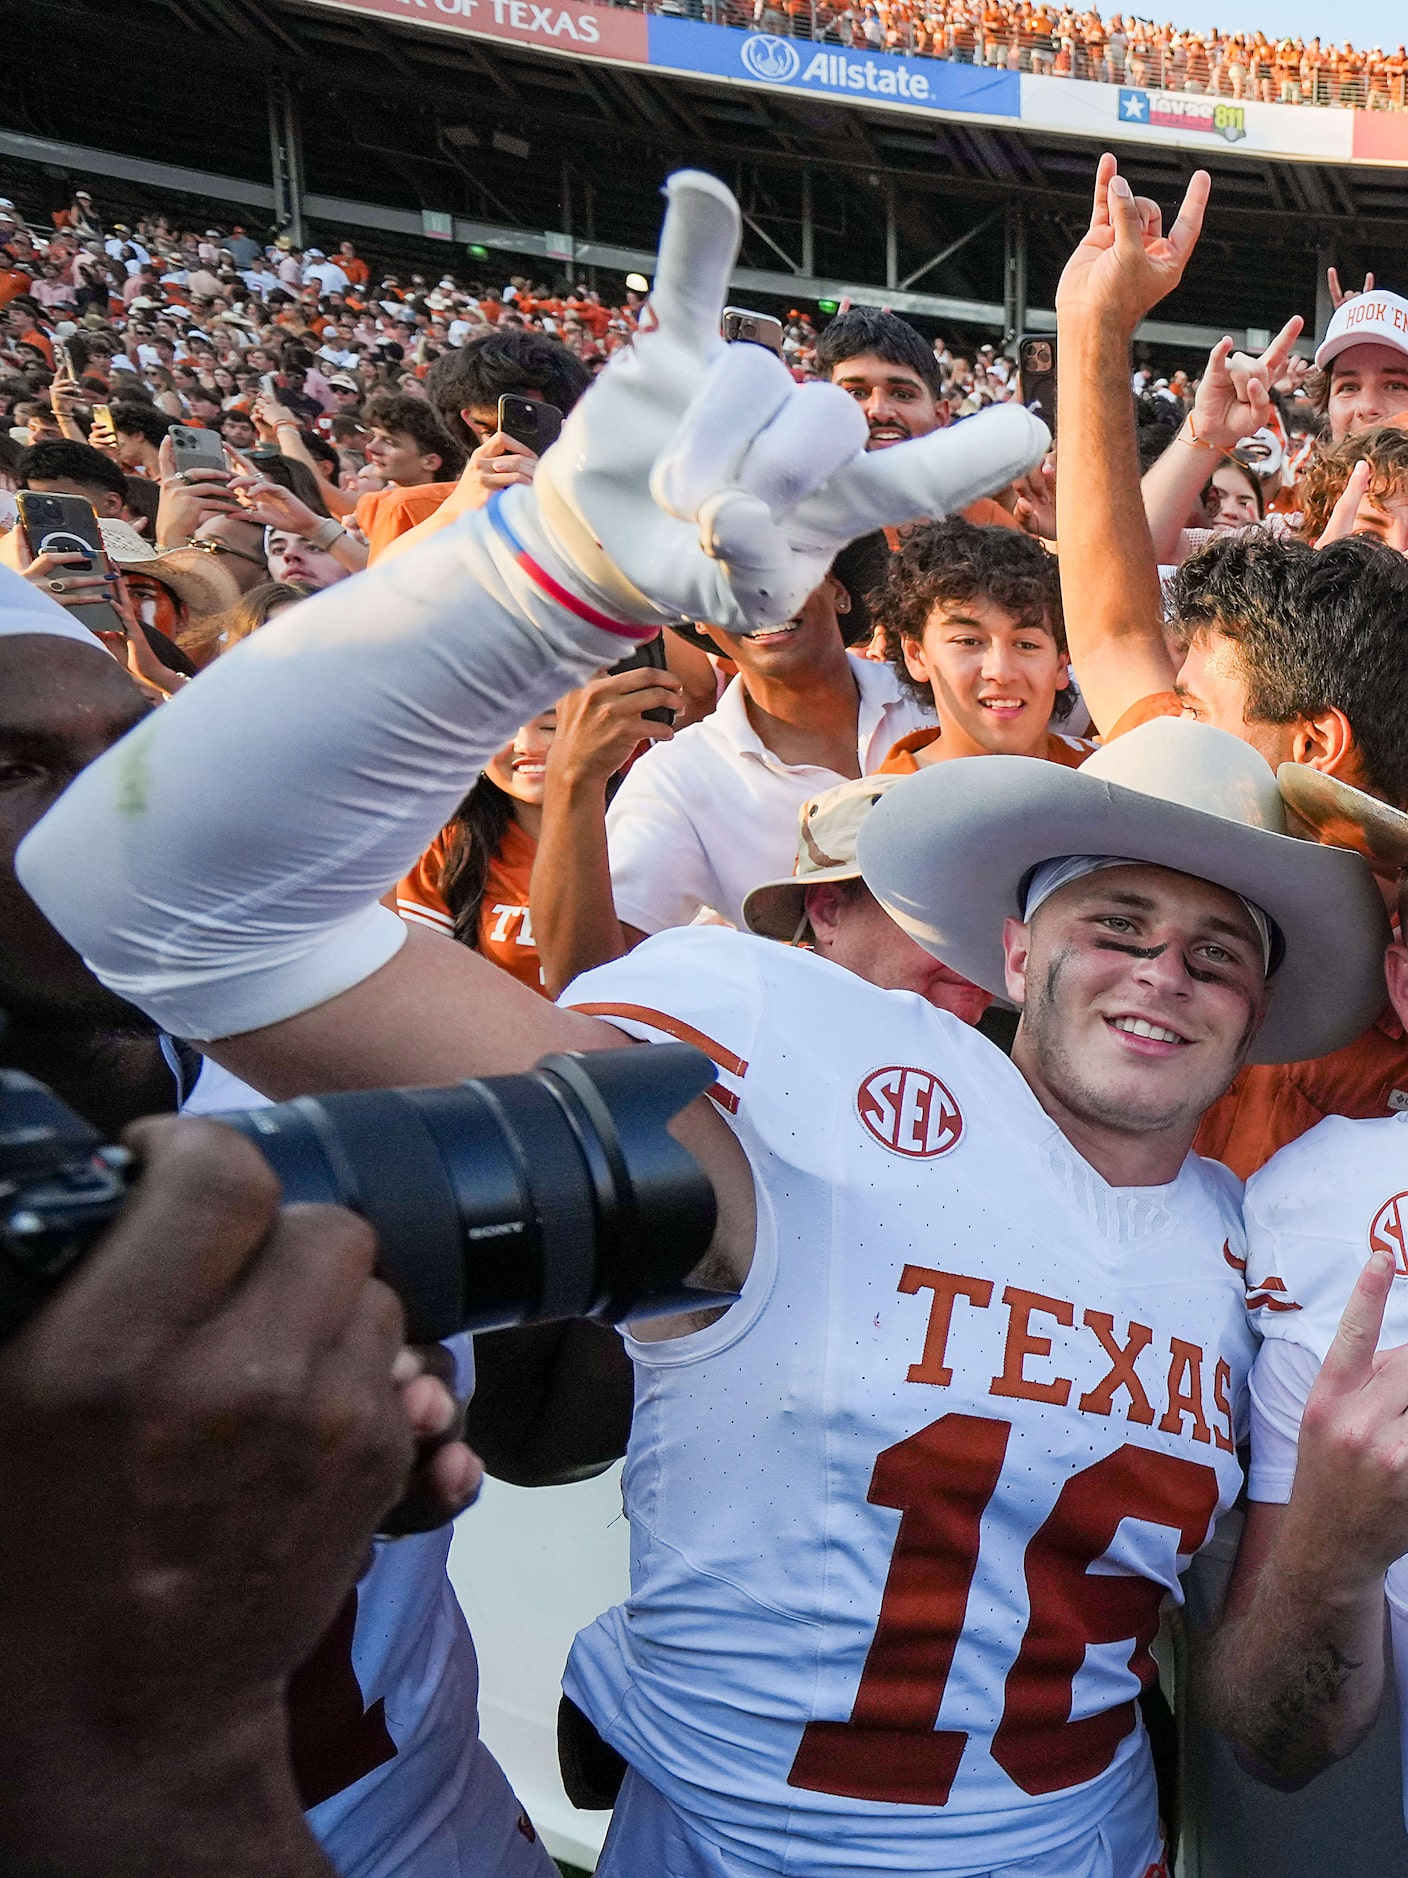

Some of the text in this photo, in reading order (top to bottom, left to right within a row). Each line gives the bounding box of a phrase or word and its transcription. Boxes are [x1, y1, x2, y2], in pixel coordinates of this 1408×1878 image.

[489, 0, 600, 43] TEXAS
[801, 53, 930, 100] Allstate
[1214, 104, 1244, 130] 811
[1345, 302, 1388, 330] HOOK
[865, 1069, 957, 1153] SEC
[469, 1222, 526, 1240] SONY
[897, 1263, 1235, 1456] TEXAS
[787, 1412, 1220, 1807] 16
